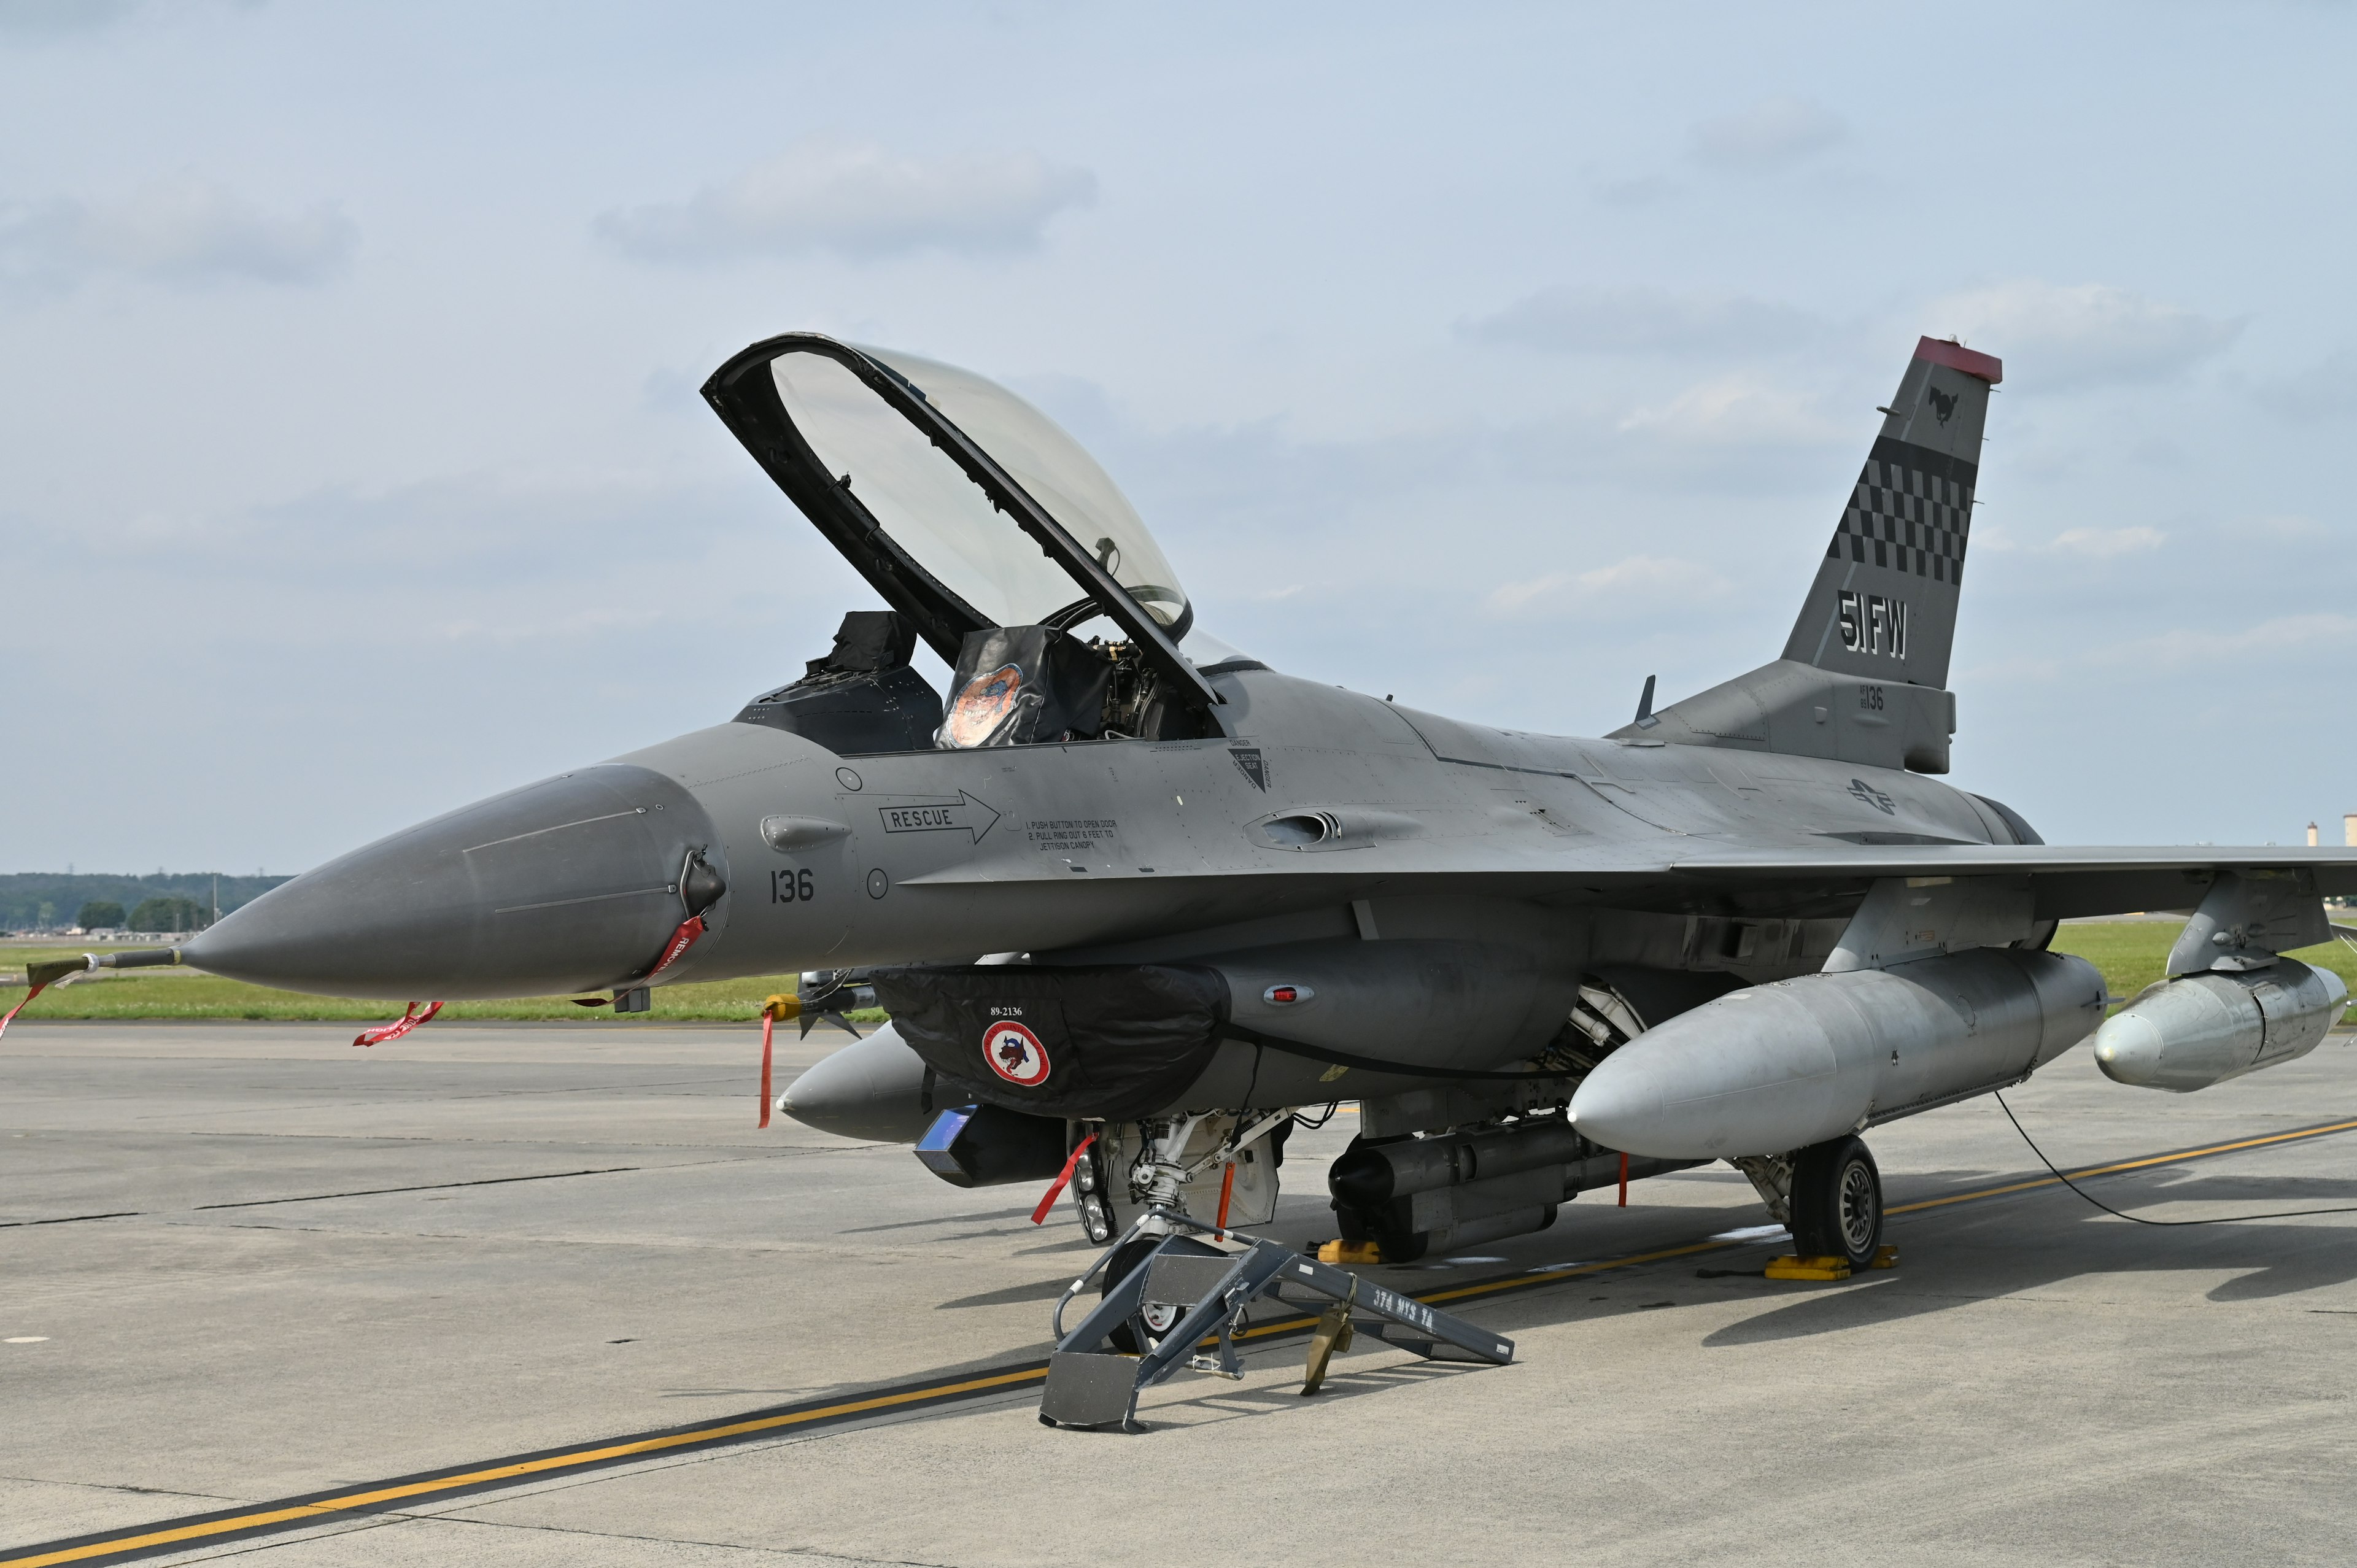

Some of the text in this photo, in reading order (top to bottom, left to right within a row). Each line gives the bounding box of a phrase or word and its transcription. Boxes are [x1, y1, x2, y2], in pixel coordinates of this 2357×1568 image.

[1867, 686, 1883, 710] 136
[1233, 760, 1256, 789] DANGER
[891, 809, 953, 827] RESCUE
[1040, 841, 1095, 851] JETTISON CANOPY
[772, 868, 813, 903] 136
[991, 1007, 1022, 1016] 89-2136
